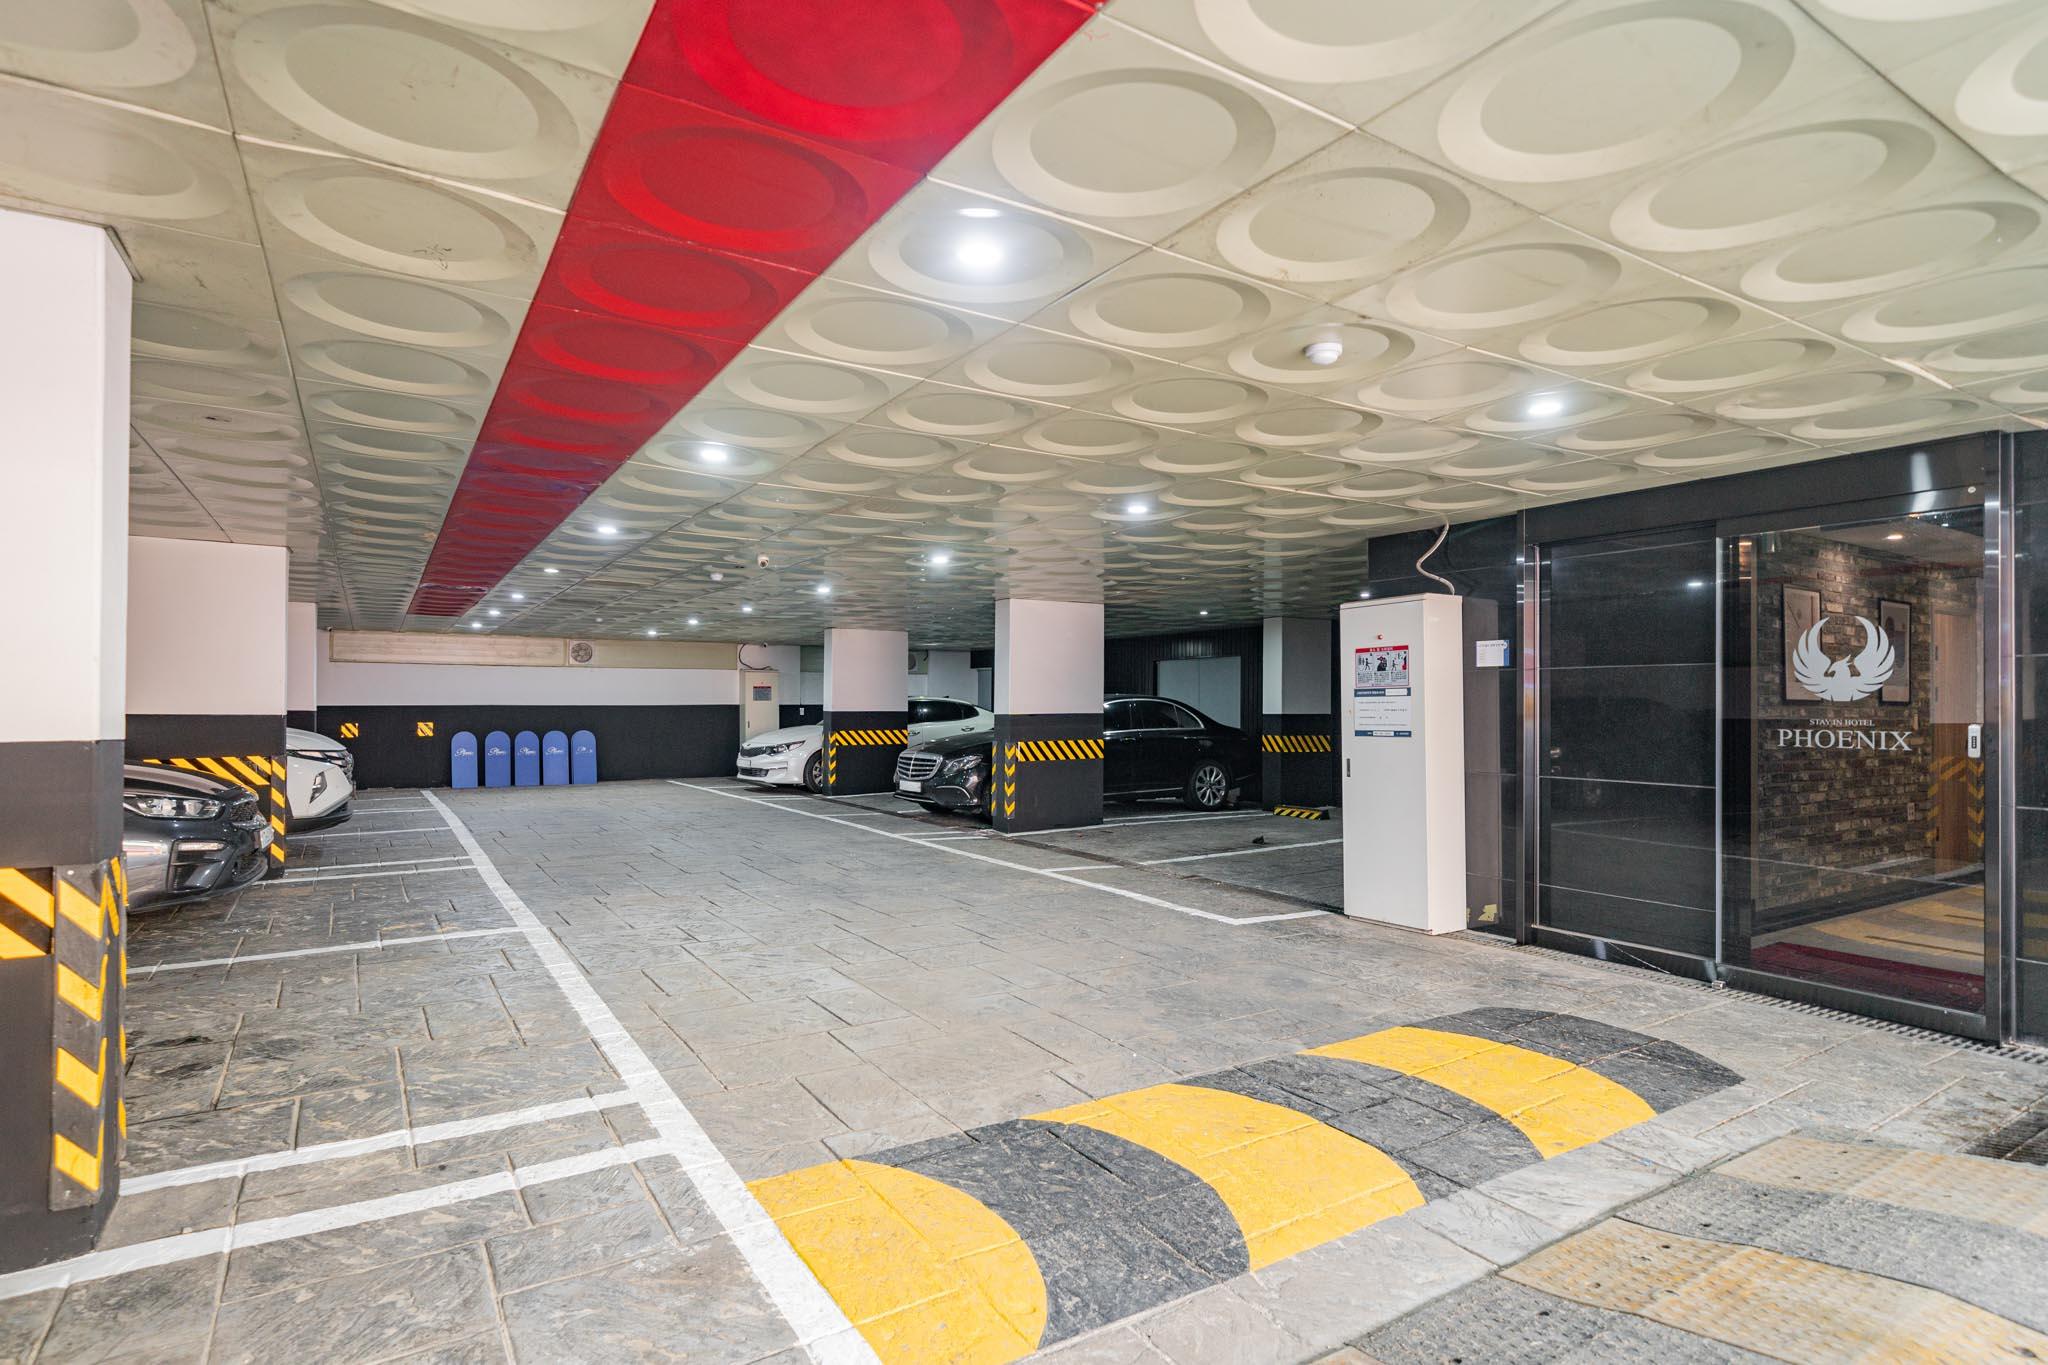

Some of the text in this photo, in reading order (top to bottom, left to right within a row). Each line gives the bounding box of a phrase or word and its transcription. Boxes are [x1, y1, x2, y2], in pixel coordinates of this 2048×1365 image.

[1809, 718, 1831, 726] STAY
[1845, 719, 1875, 727] HOTEL
[1777, 728, 1913, 751] PHOENIX
